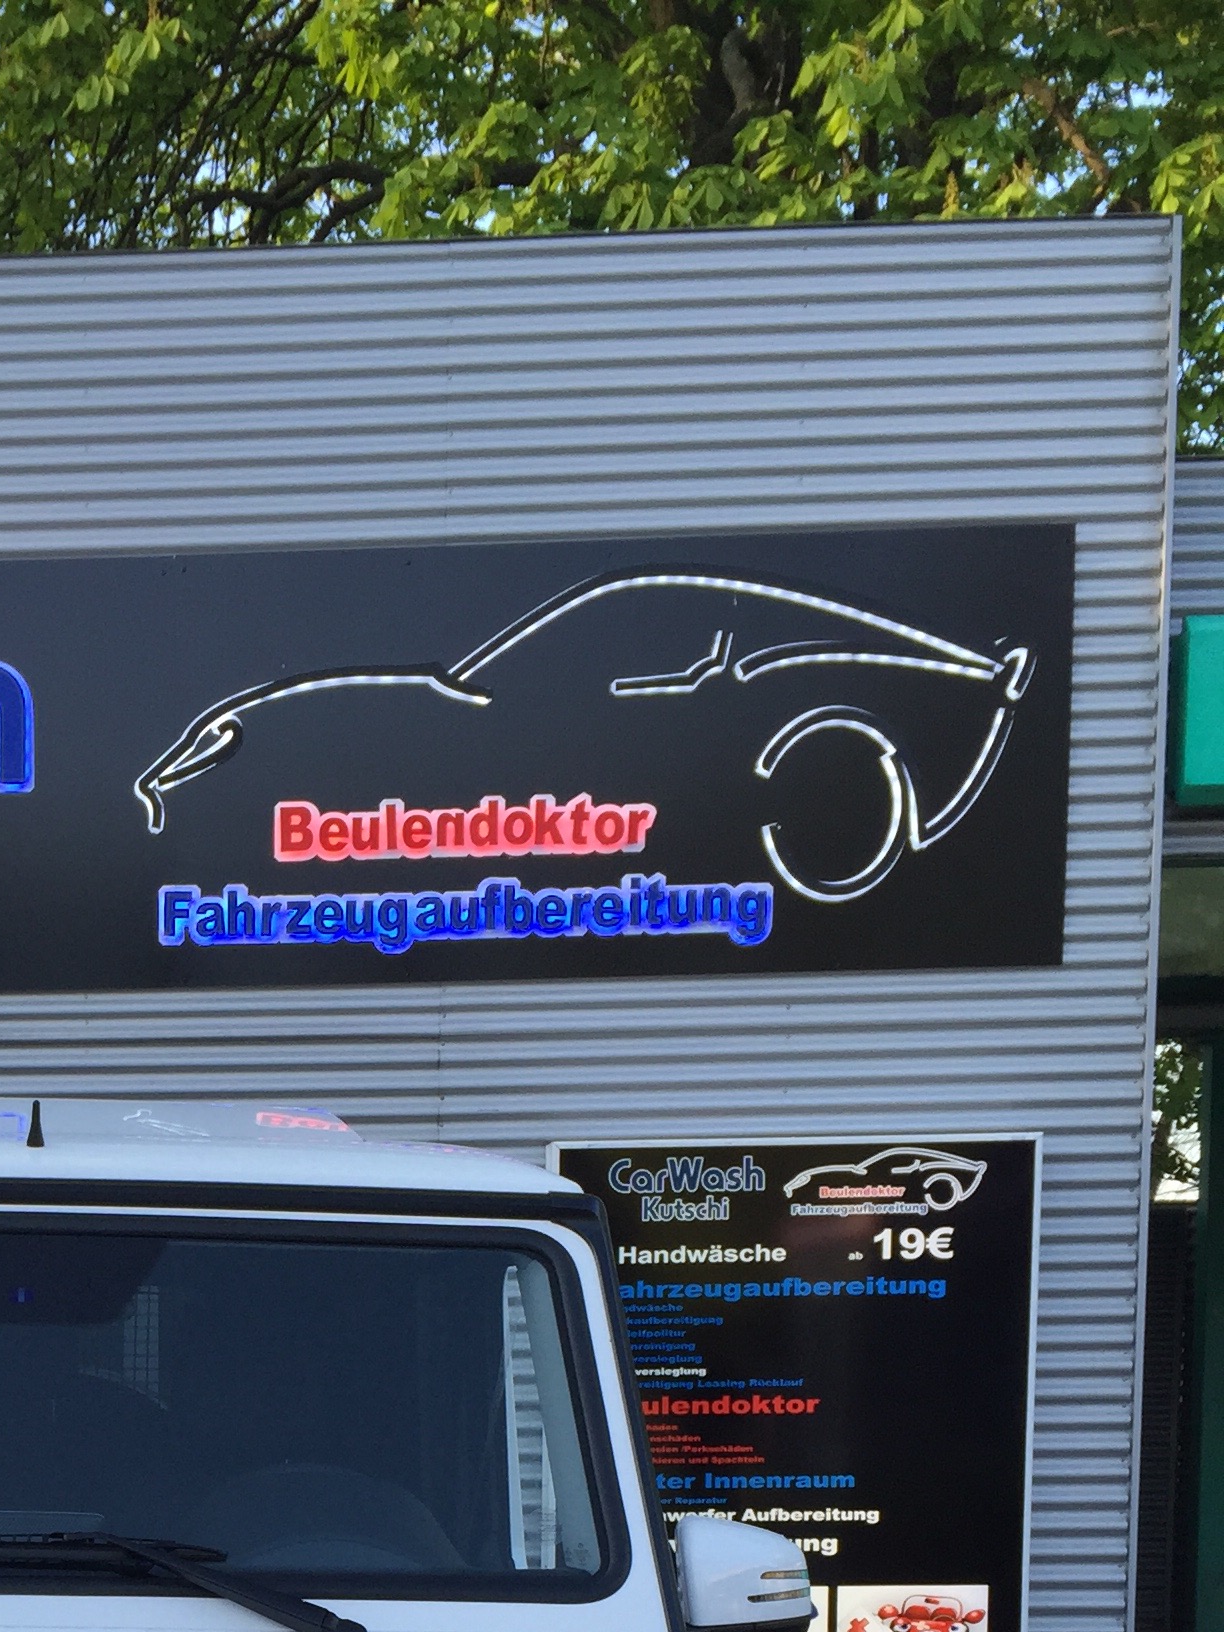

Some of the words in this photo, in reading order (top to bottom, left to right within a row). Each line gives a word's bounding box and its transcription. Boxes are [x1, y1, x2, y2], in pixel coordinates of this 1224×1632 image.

[275, 793, 657, 862] Beulendoktor
[158, 872, 774, 955] Fahrzeugaufbereitung
[608, 1155, 766, 1194] CarWash
[818, 1186, 906, 1198] Beulendoktor
[641, 1195, 730, 1223] Kutschi
[790, 1201, 928, 1217] Fahrzeugaufbereitung
[618, 1244, 787, 1265] Handwäsche
[848, 1251, 863, 1261] ab
[873, 1227, 955, 1260] 19€
[619, 1276, 947, 1301] ahrzeugaufbereitung
[630, 1342, 696, 1352] nreinigung
[633, 1354, 703, 1364] versieglung
[634, 1367, 707, 1377] versieglung
[641, 1394, 821, 1415] ulendoktor
[656, 1474, 696, 1489] ter
[705, 1472, 856, 1489] Innenraum
[741, 1508, 880, 1525] Aufbereitung
